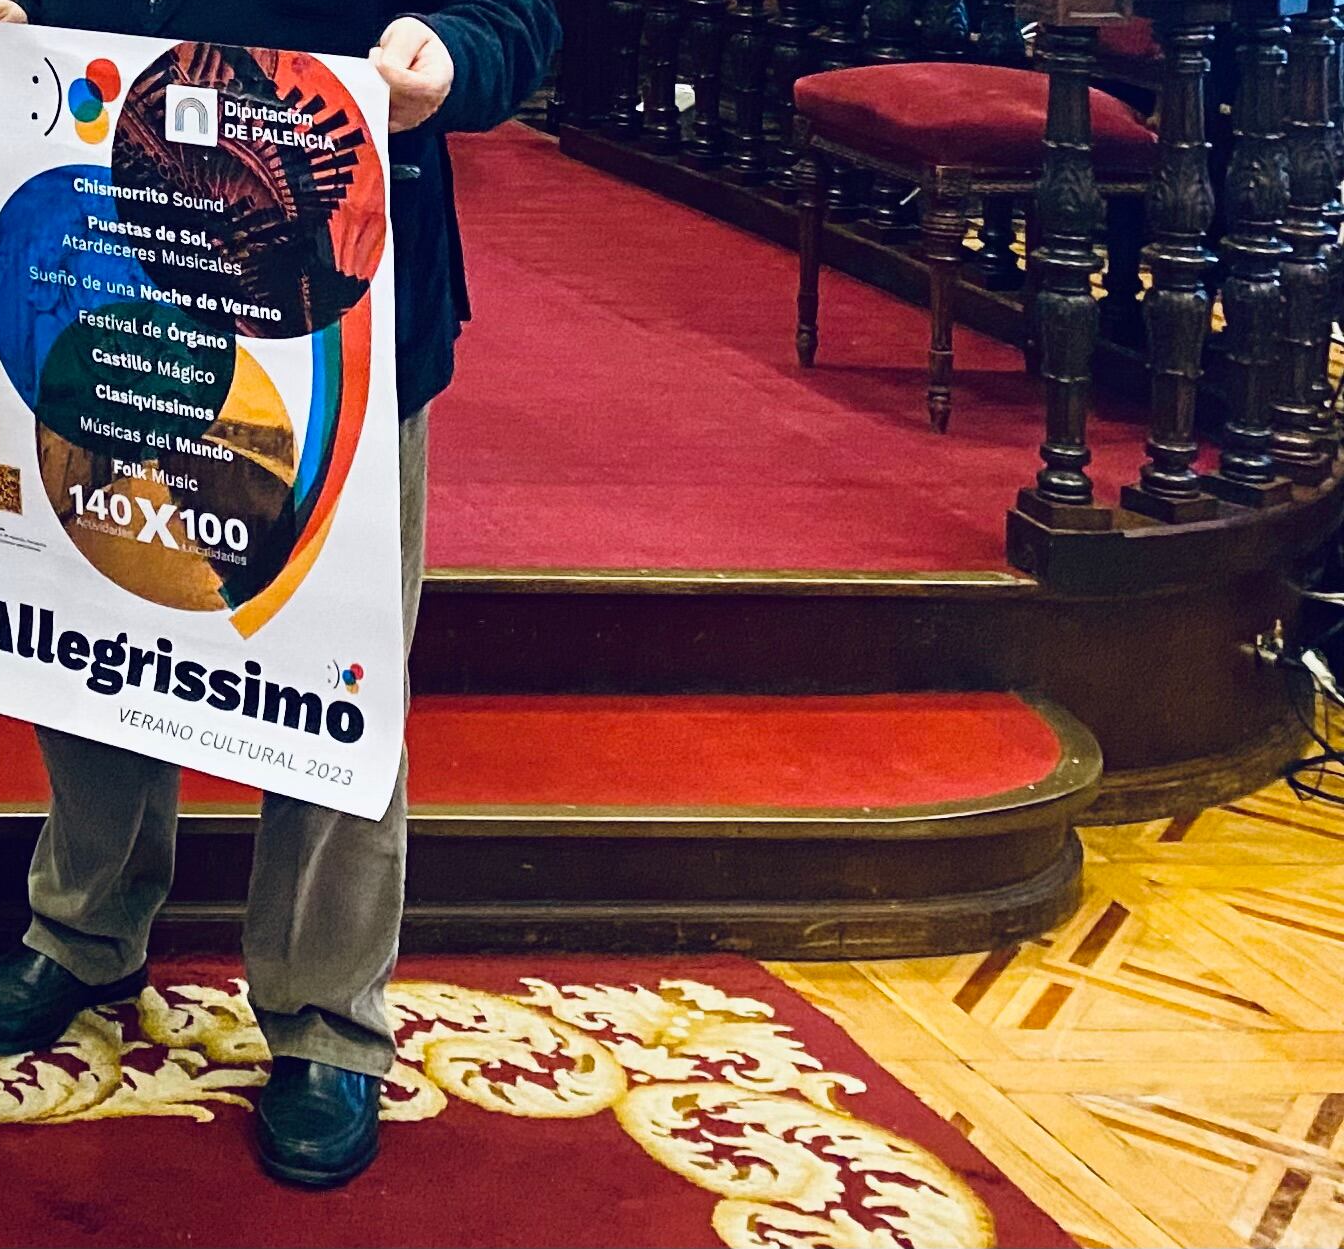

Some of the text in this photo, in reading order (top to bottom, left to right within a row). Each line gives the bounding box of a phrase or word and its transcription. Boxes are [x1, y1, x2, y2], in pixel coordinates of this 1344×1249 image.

[224, 100, 313, 125] Diputación
[224, 123, 336, 151] DE PALENCIA
[73, 177, 224, 213] Chismorrito Sound
[87, 215, 212, 250] Puestas de Sol,
[62, 233, 242, 277] Atardeceres Musicales
[28, 266, 282, 322] Sueño de una Noche de Verano
[78, 310, 228, 350] Festival de Órgano
[92, 348, 216, 385] Castillo Mágico
[80, 416, 234, 462] Músicas del Mundo
[113, 459, 199, 492] Folk Music
[121, 708, 353, 785] VERANO CULTURAL 2023
